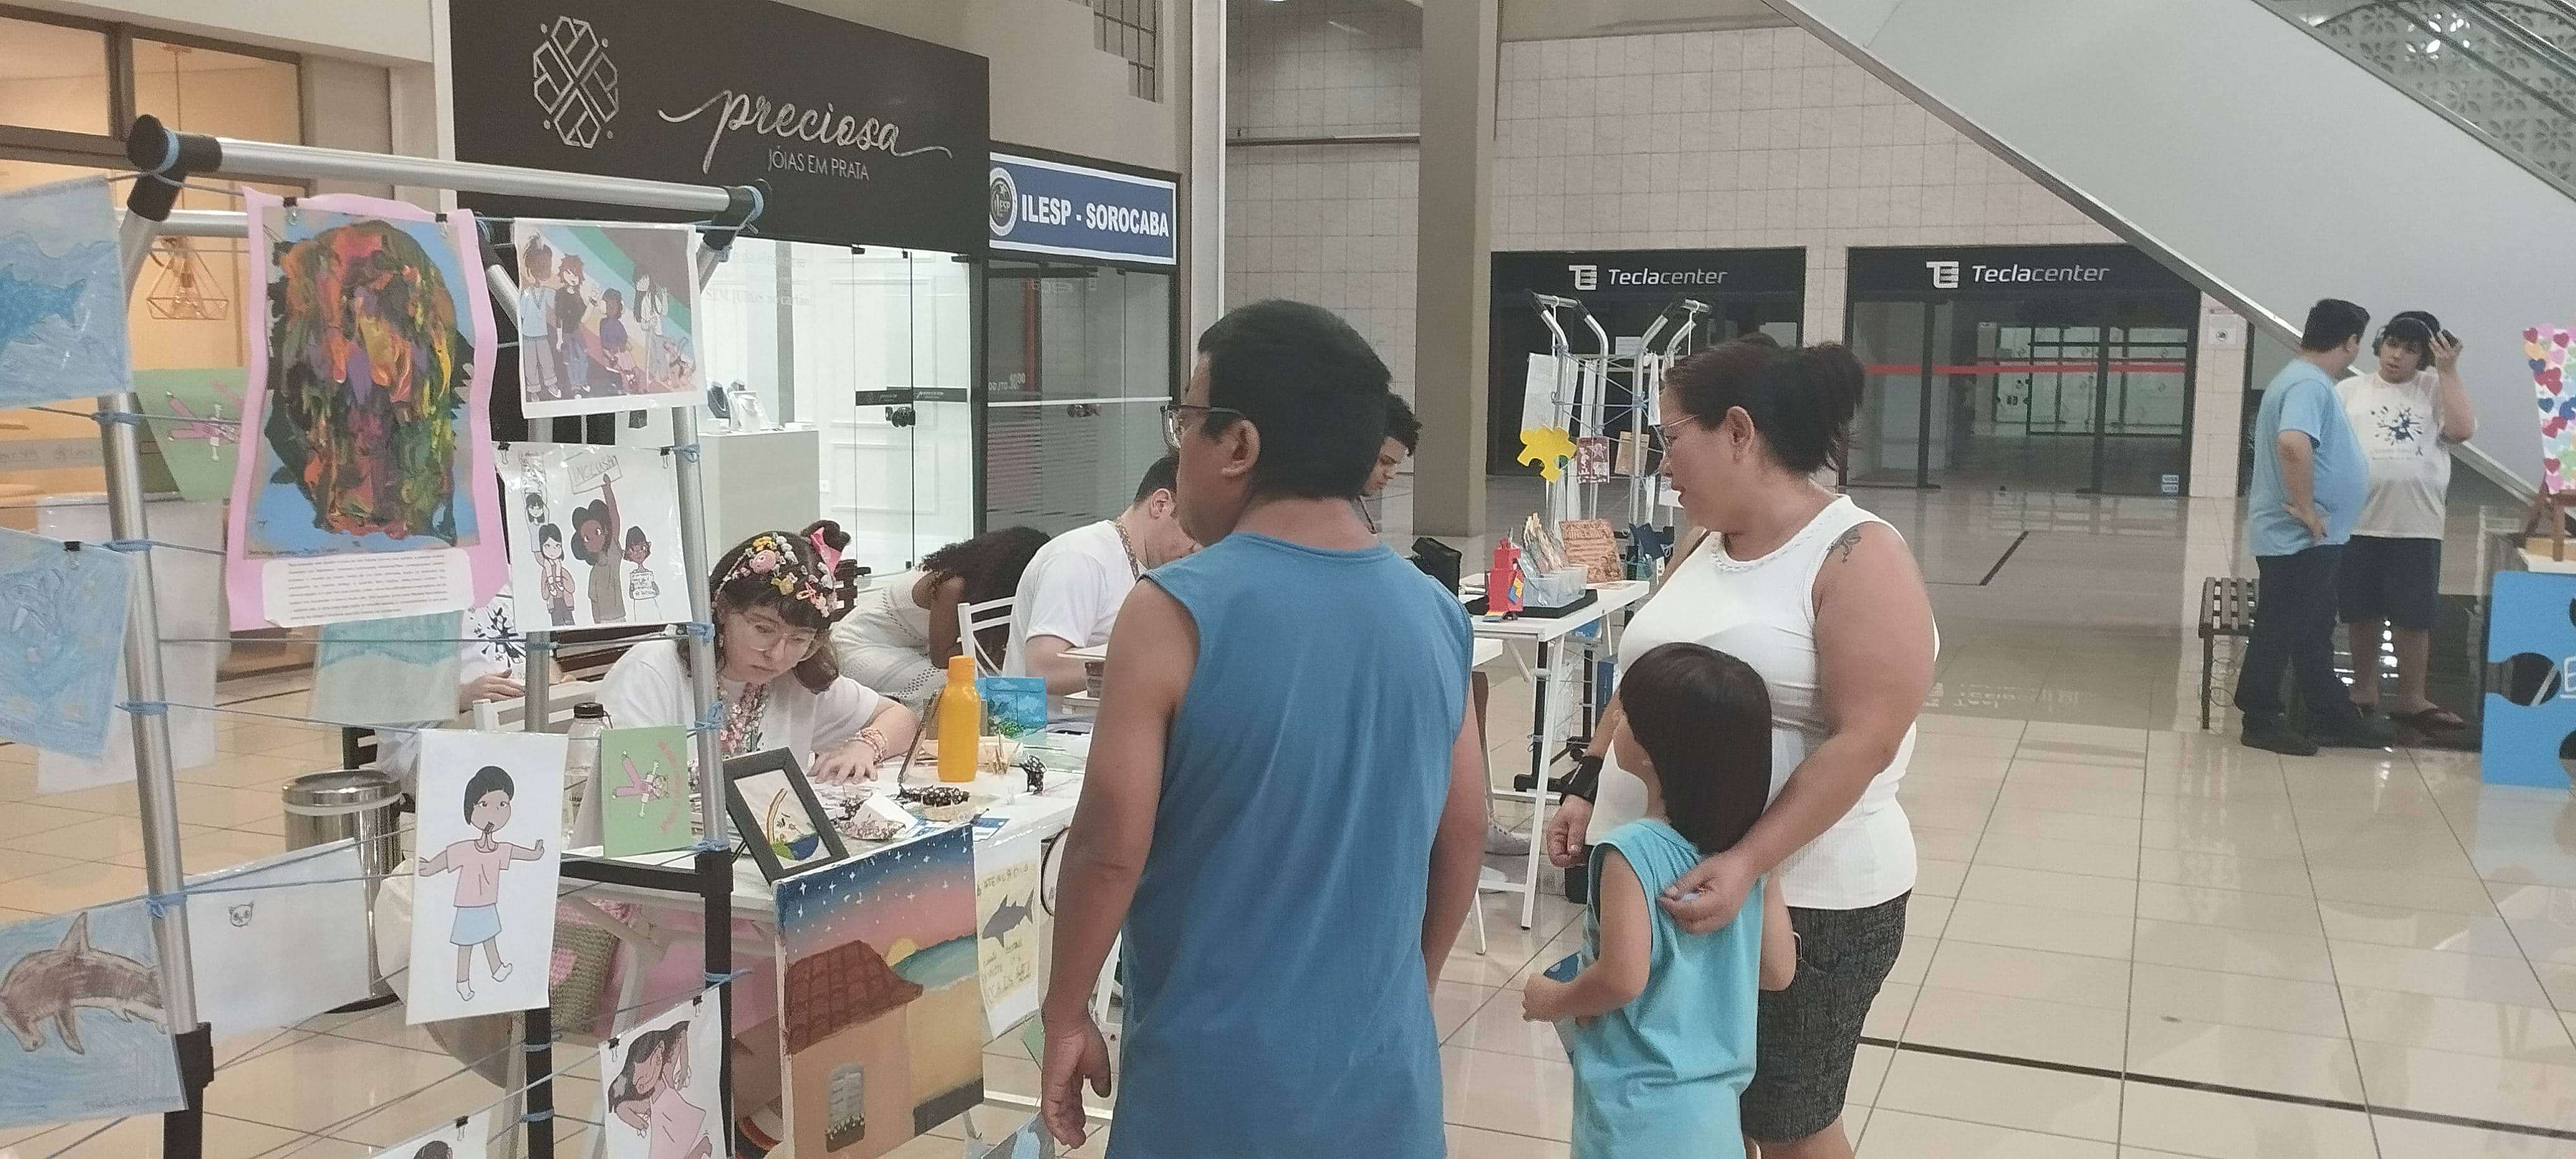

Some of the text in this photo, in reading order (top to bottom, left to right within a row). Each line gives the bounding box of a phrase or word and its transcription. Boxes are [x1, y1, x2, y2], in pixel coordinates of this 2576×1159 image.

[659, 90, 953, 174] preciosa
[768, 145, 869, 181] JÓIAS EM PRATA
[1022, 194, 1072, 225] ILESP
[1086, 202, 1169, 237] SOROCABA
[1608, 268, 1728, 285] Teclacenter
[1972, 263, 2110, 283] Teclacenter
